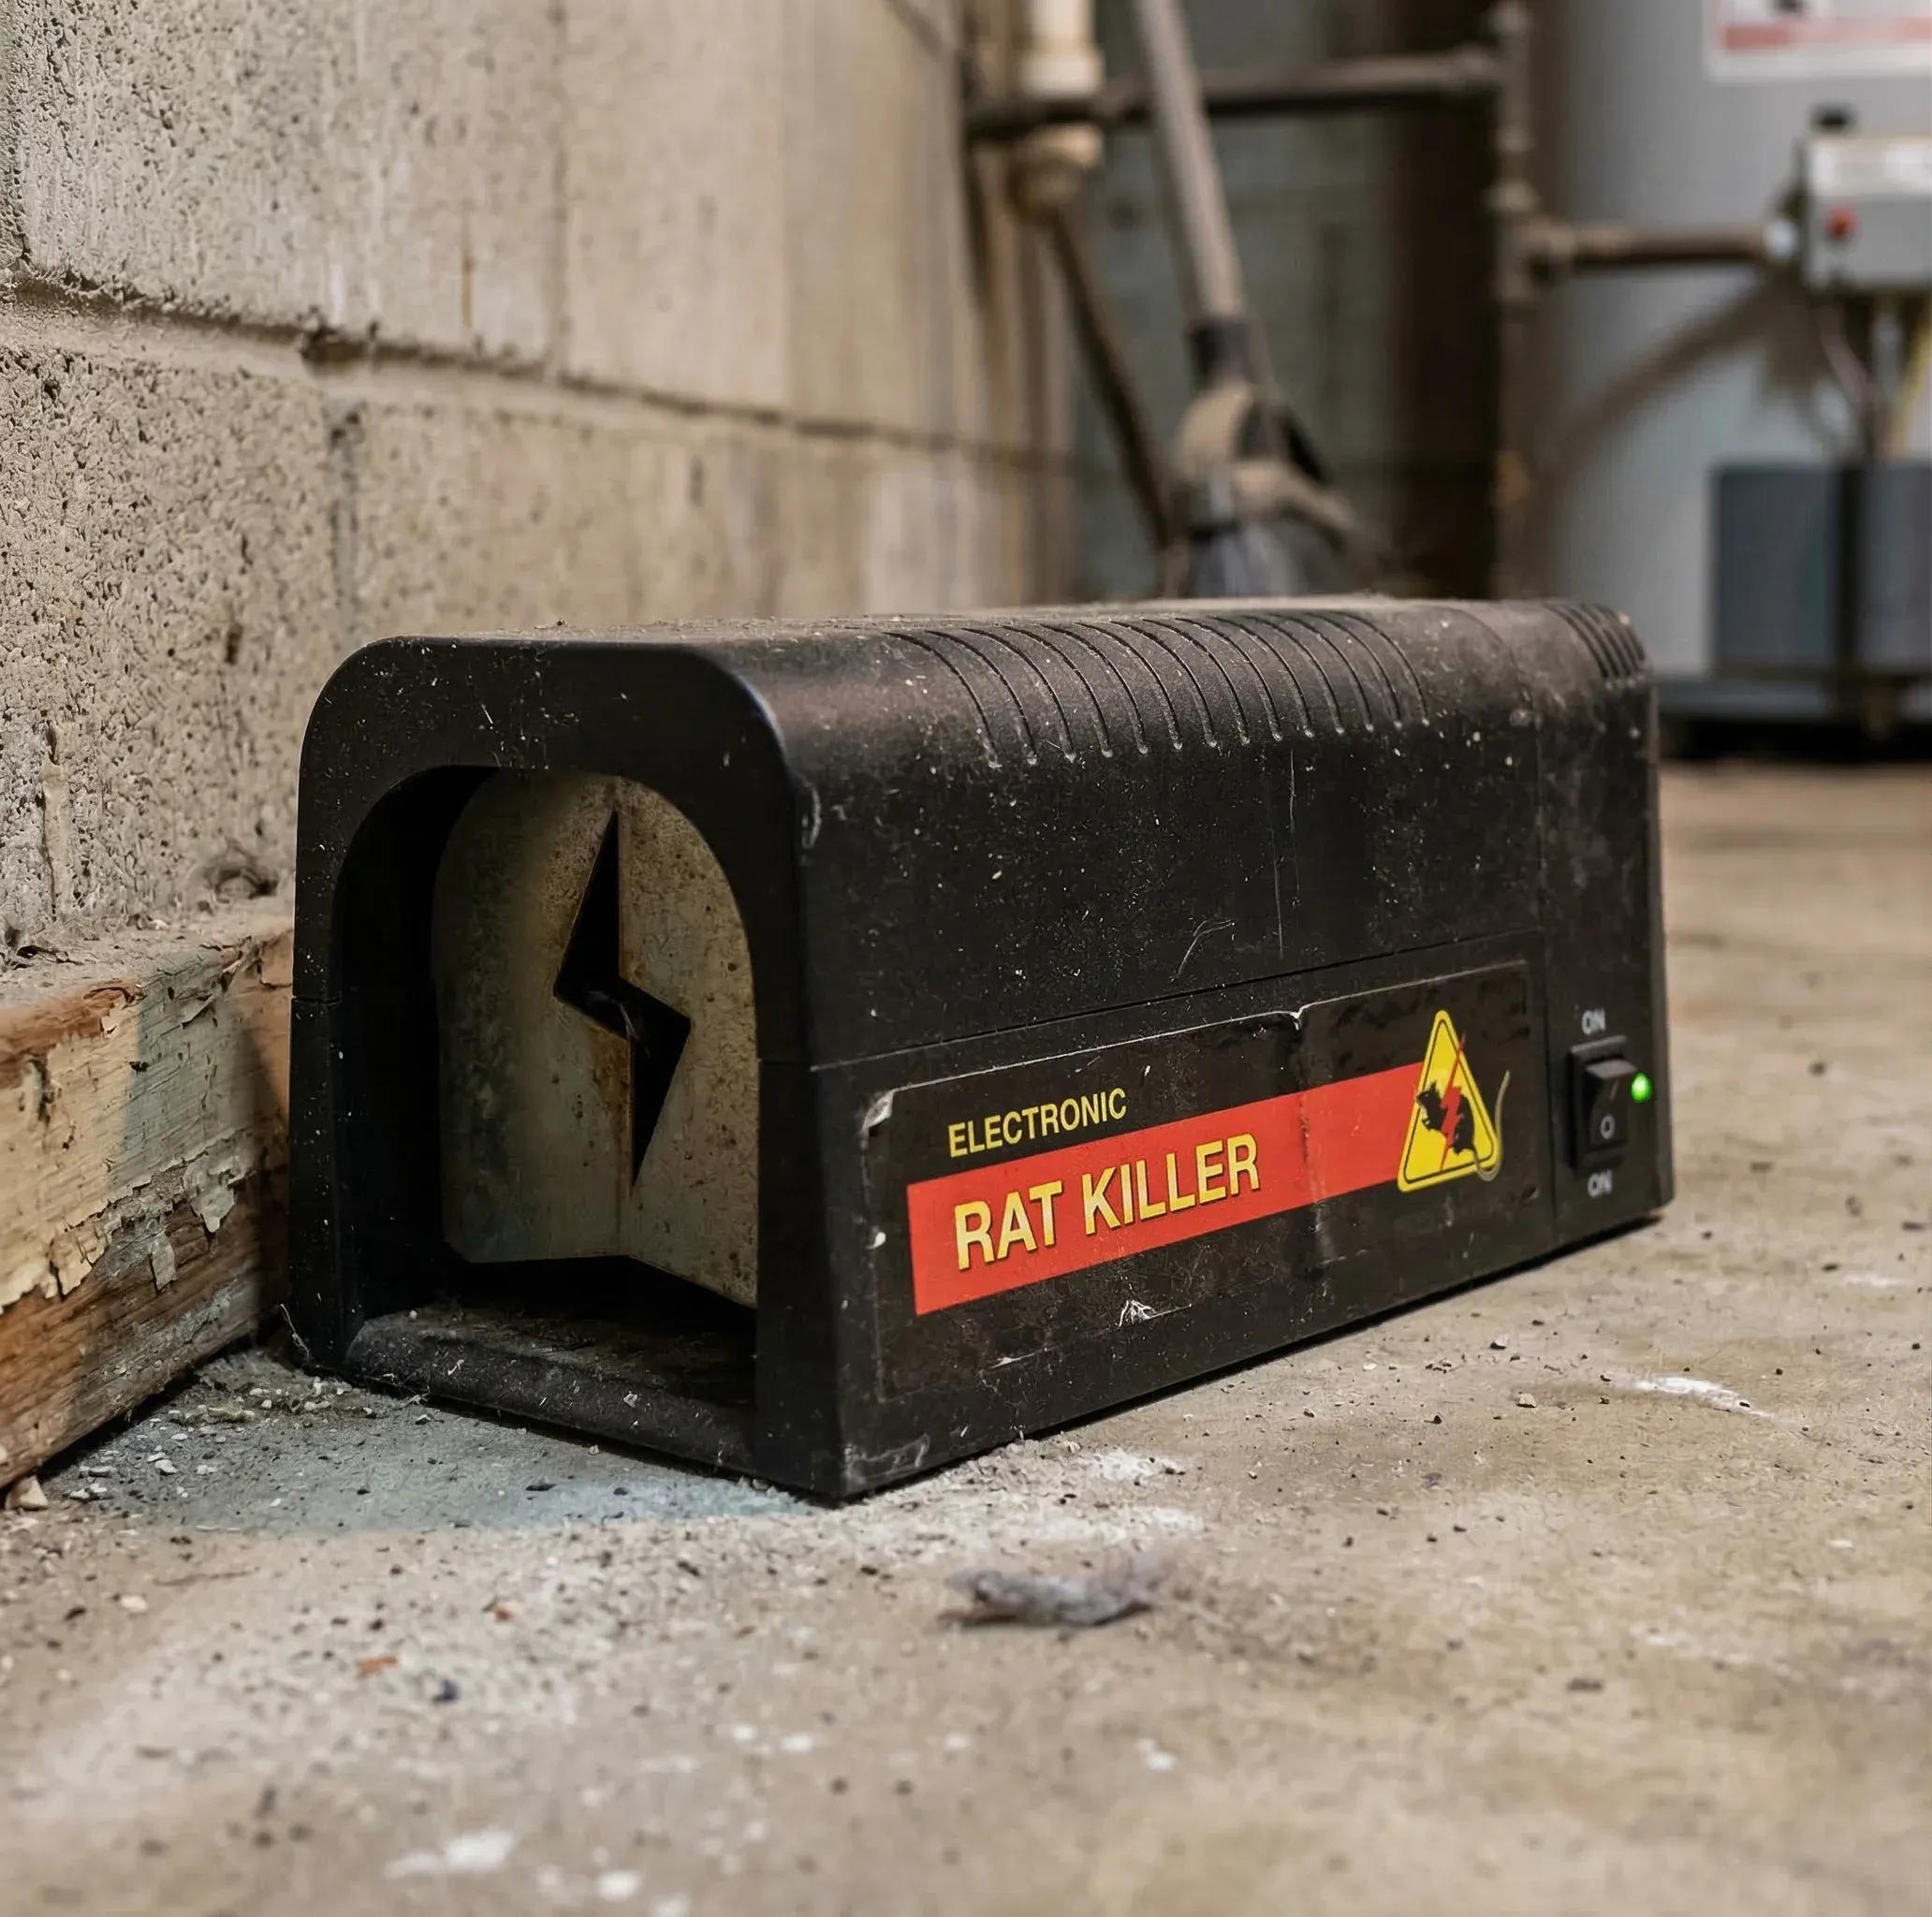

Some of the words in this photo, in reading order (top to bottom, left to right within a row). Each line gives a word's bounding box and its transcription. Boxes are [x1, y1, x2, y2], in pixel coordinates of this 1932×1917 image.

[1582, 1008, 1605, 1035] ON
[948, 1087, 1127, 1158] ELECTRONIC
[954, 1180, 1063, 1271] RAT
[1082, 1133, 1260, 1235] KILLER
